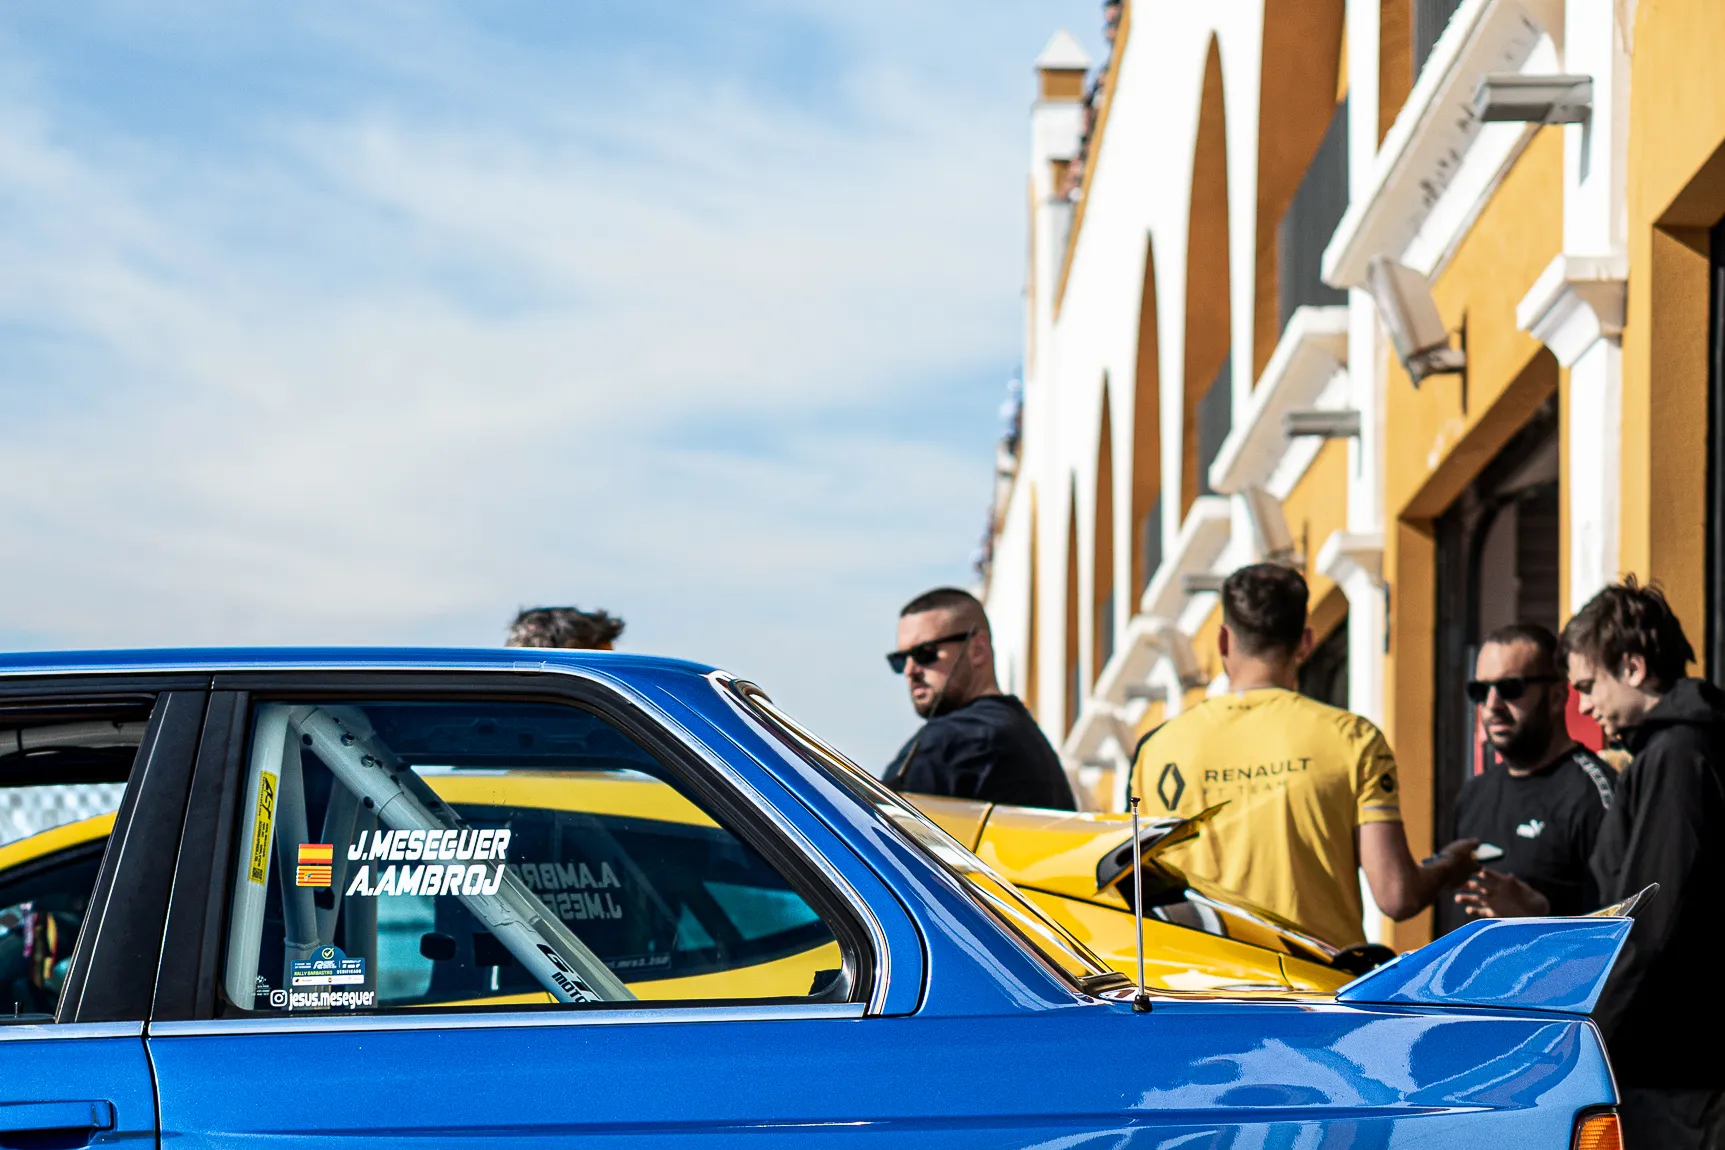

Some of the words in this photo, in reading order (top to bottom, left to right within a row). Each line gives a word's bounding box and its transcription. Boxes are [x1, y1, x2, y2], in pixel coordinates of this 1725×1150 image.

[1204, 757, 1312, 782] RENAULT
[347, 829, 511, 860] J.MESEGUER
[345, 864, 506, 896] A.AMBROJ
[536, 943, 603, 1001] GT
[288, 988, 375, 1011] jesus.meseguer
